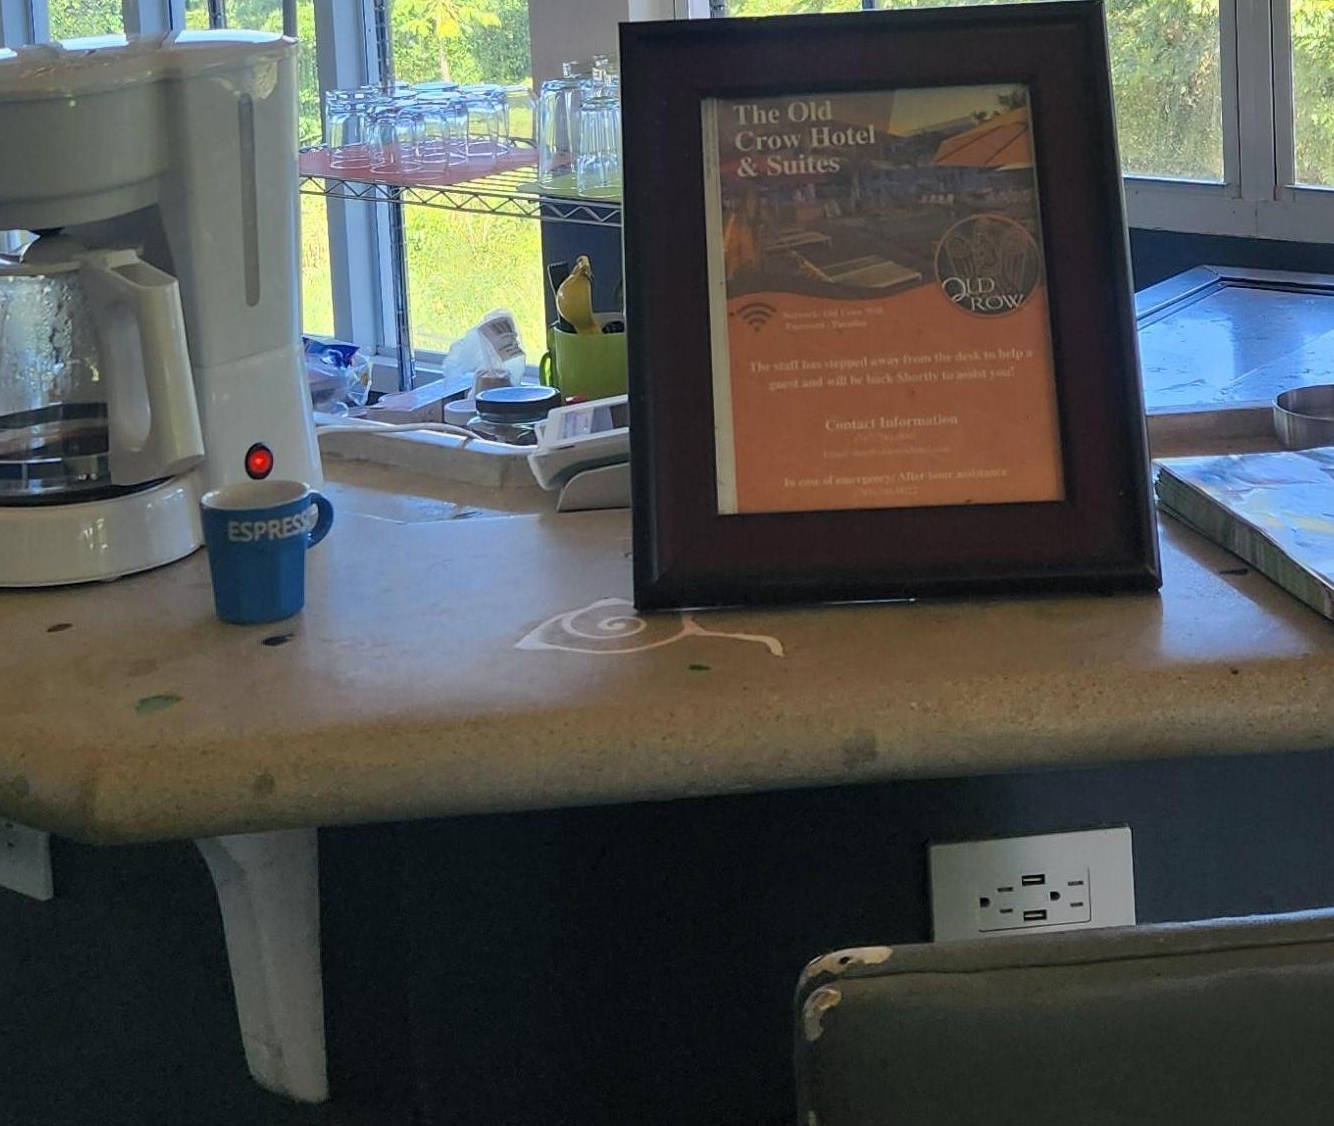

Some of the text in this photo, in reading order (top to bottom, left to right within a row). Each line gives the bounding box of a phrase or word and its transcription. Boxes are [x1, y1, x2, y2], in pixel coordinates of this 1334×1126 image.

[733, 100, 833, 124] The Old
[735, 125, 876, 151] Crow Hotel
[737, 154, 841, 177] & Suites
[942, 277, 995, 303] OLD
[751, 361, 770, 372] The
[773, 360, 799, 371] staff
[802, 359, 821, 370] has
[824, 356, 867, 371] stepped
[870, 357, 900, 368] away
[903, 354, 931, 365] from
[934, 353, 952, 363] the
[955, 351, 982, 362] desk
[984, 350, 996, 359] to
[998, 348, 1023, 362] help
[802, 376, 823, 387] and
[827, 375, 847, 386] will
[867, 372, 893, 384] back
[942, 370, 954, 381] to
[826, 416, 958, 431] Contact Information
